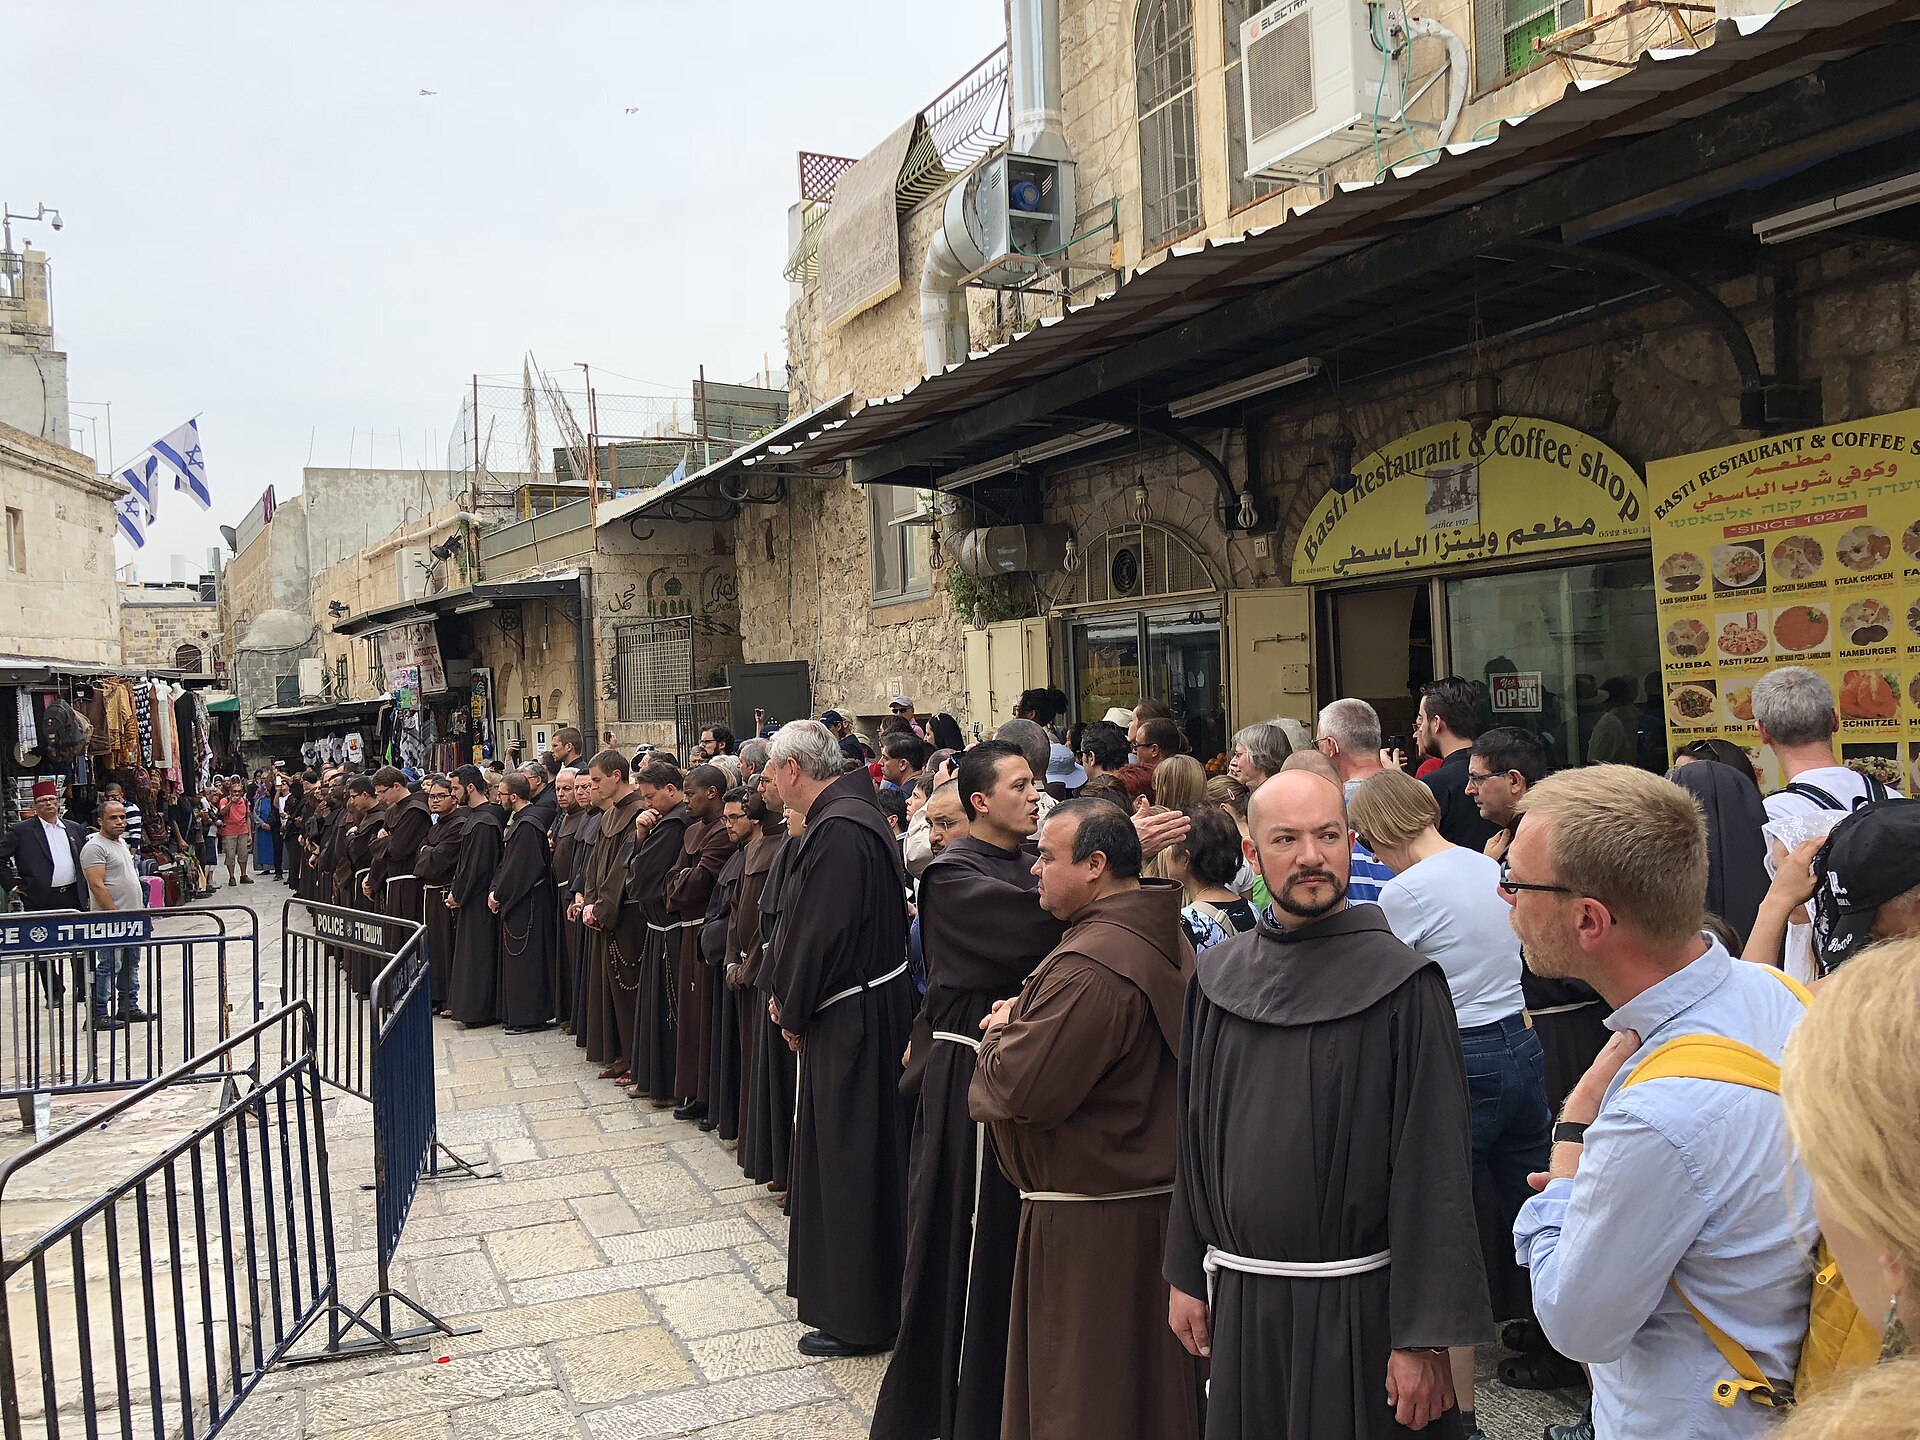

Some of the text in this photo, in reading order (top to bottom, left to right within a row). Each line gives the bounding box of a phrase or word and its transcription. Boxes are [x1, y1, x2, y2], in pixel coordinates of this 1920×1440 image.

[1261, 0, 1308, 30] ELECTRA
[1745, 452, 1832, 479] مطعم
[1654, 480, 1696, 520] BASTI
[1698, 436, 1805, 487] RESTAURANT
[1810, 434, 1826, 449] &
[1831, 432, 1906, 452] COFFEE
[1781, 469, 1832, 495] شوب
[1304, 494, 1348, 566] Basti
[1353, 431, 1462, 505] Restaurant
[1494, 425, 1573, 470] Coffee
[1578, 451, 1640, 523] shop
[1761, 499, 1802, 514] קפה
[1455, 518, 1469, 527] 1927
[1332, 515, 1597, 577] مطعم وبيتزا الباسطي
[1834, 576, 1859, 586] STEAK
[1860, 572, 1894, 583] CHICKEN
[1714, 591, 1735, 599] CHICKEN
[1750, 587, 1767, 596] KEBAB
[1772, 584, 1796, 593] CHICKEN
[1659, 597, 1674, 605] LAMB
[1690, 593, 1708, 602] KEBAB
[1839, 646, 1897, 658] HAMBURGER
[1665, 660, 1712, 670] KUBBA
[1744, 656, 1770, 665] PIZZA
[1500, 677, 1517, 688] Yes
[1496, 687, 1537, 708] OPEN
[1842, 719, 1901, 728] SCHNITZEL
[57, 920, 144, 941] משטרה
[317, 913, 345, 937] POLICE
[354, 921, 383, 946] משטרה
